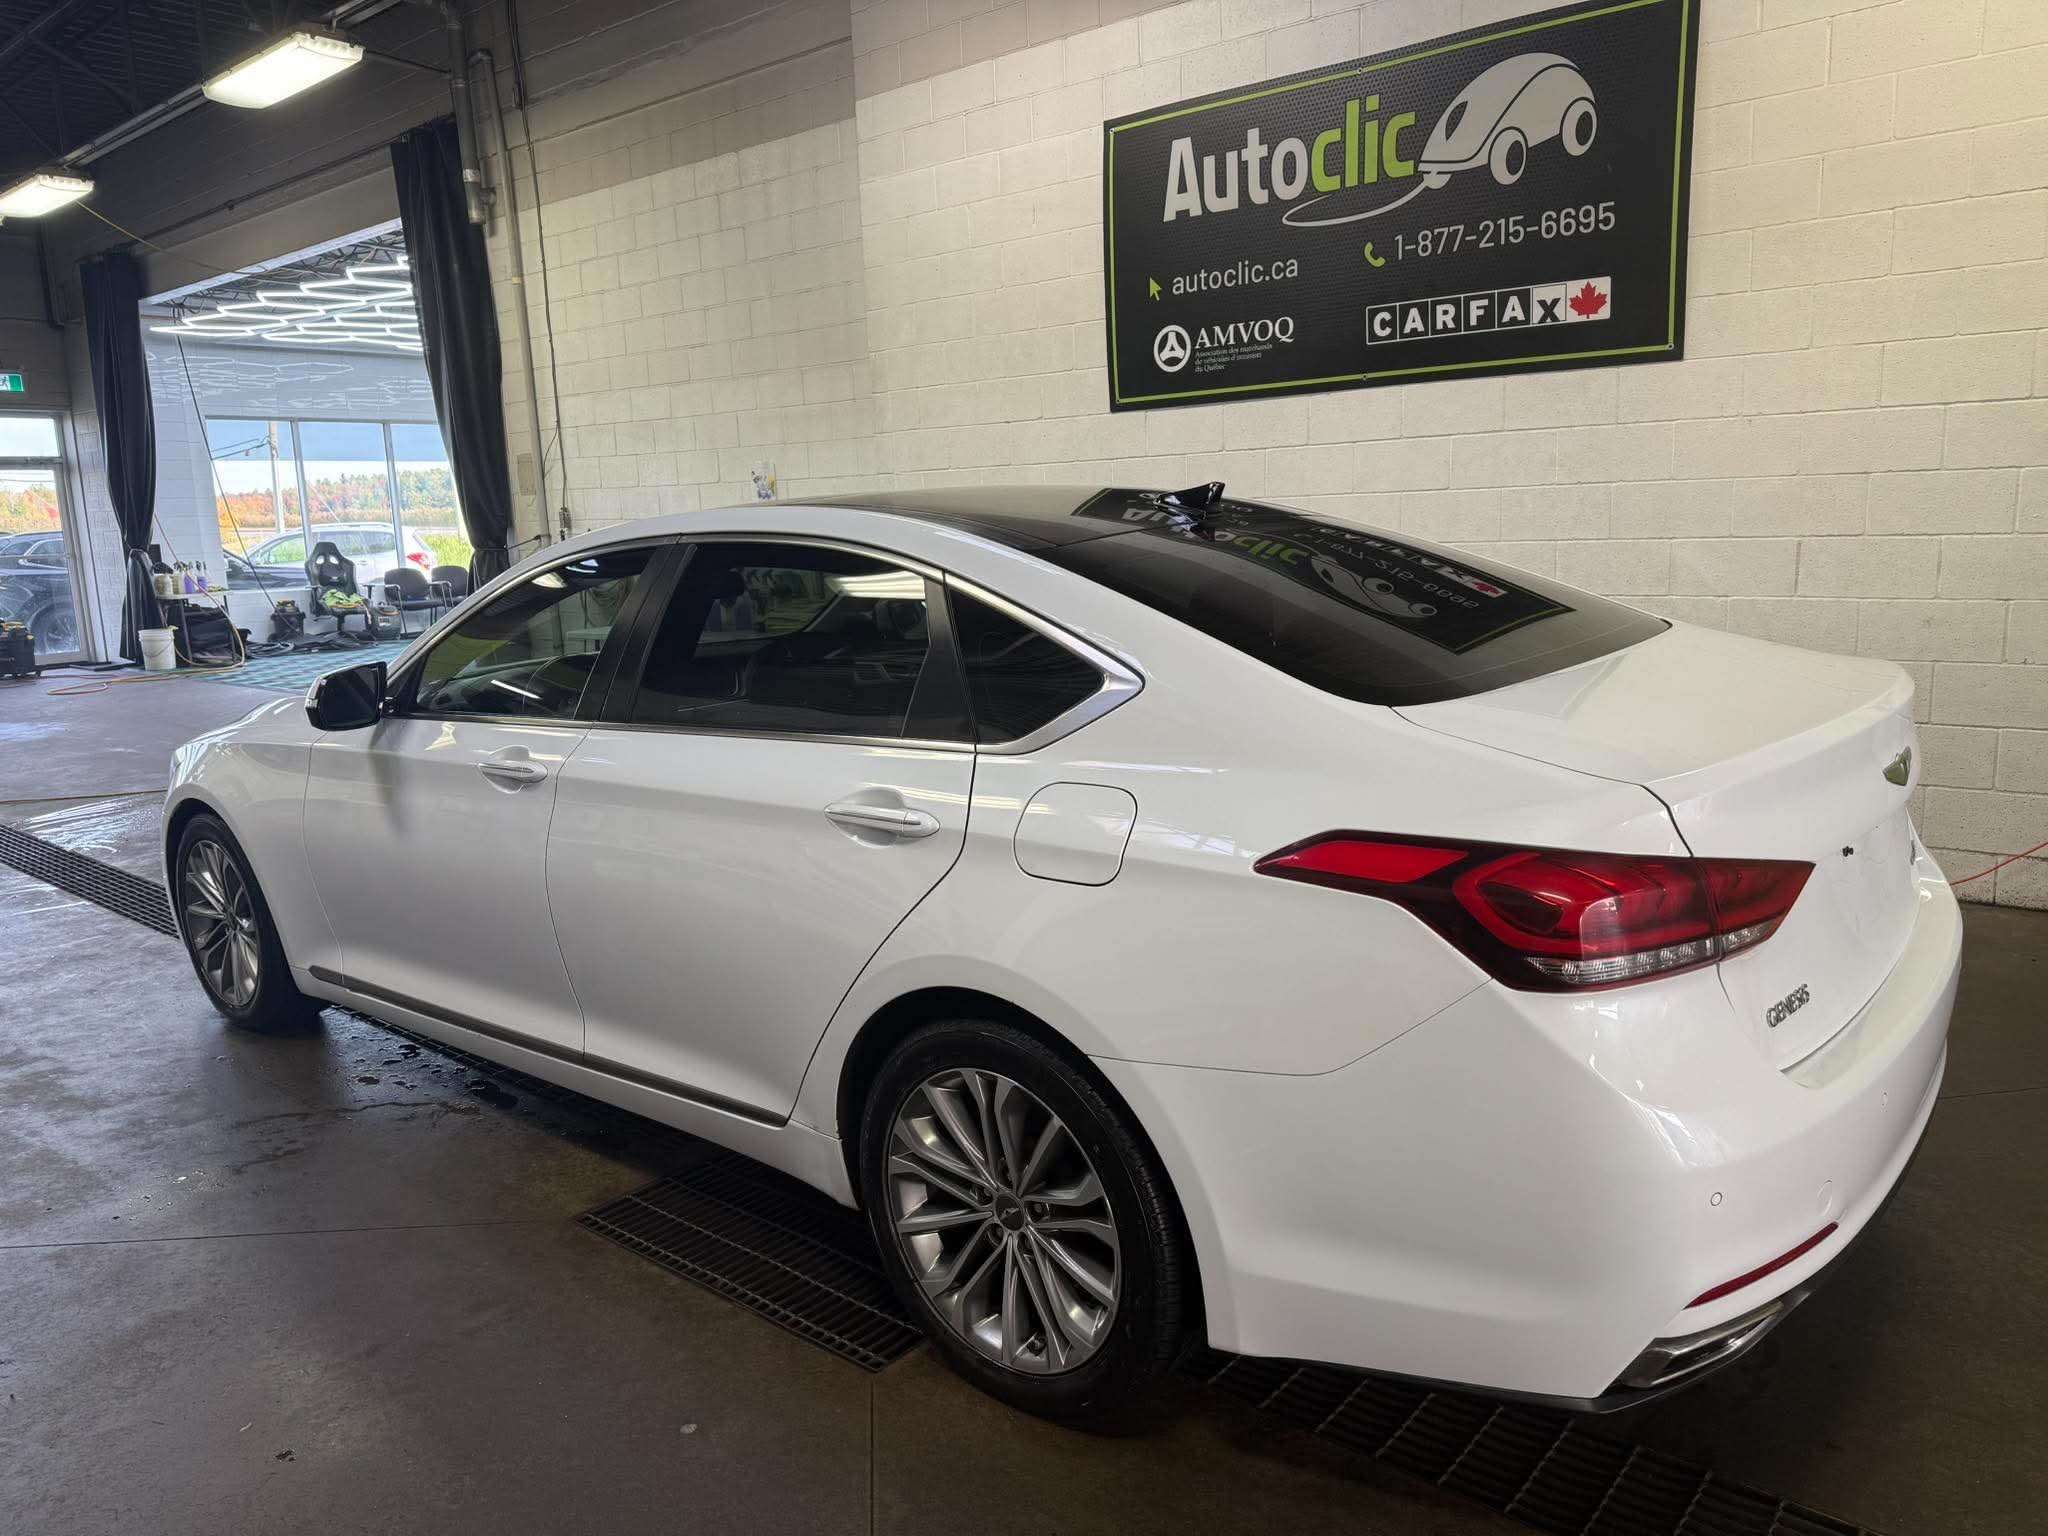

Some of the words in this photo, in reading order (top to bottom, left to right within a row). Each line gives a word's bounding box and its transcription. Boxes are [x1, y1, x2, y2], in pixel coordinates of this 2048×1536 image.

[1163, 94, 1416, 223] Autoclic
[1394, 201, 1616, 261] 1-877-215-6695
[1172, 258, 1298, 295] autoclic.ca
[1194, 316, 1295, 349] AMVOQ
[1373, 294, 1562, 337] CARFAX
[1766, 984, 1809, 1028] GENESIS
